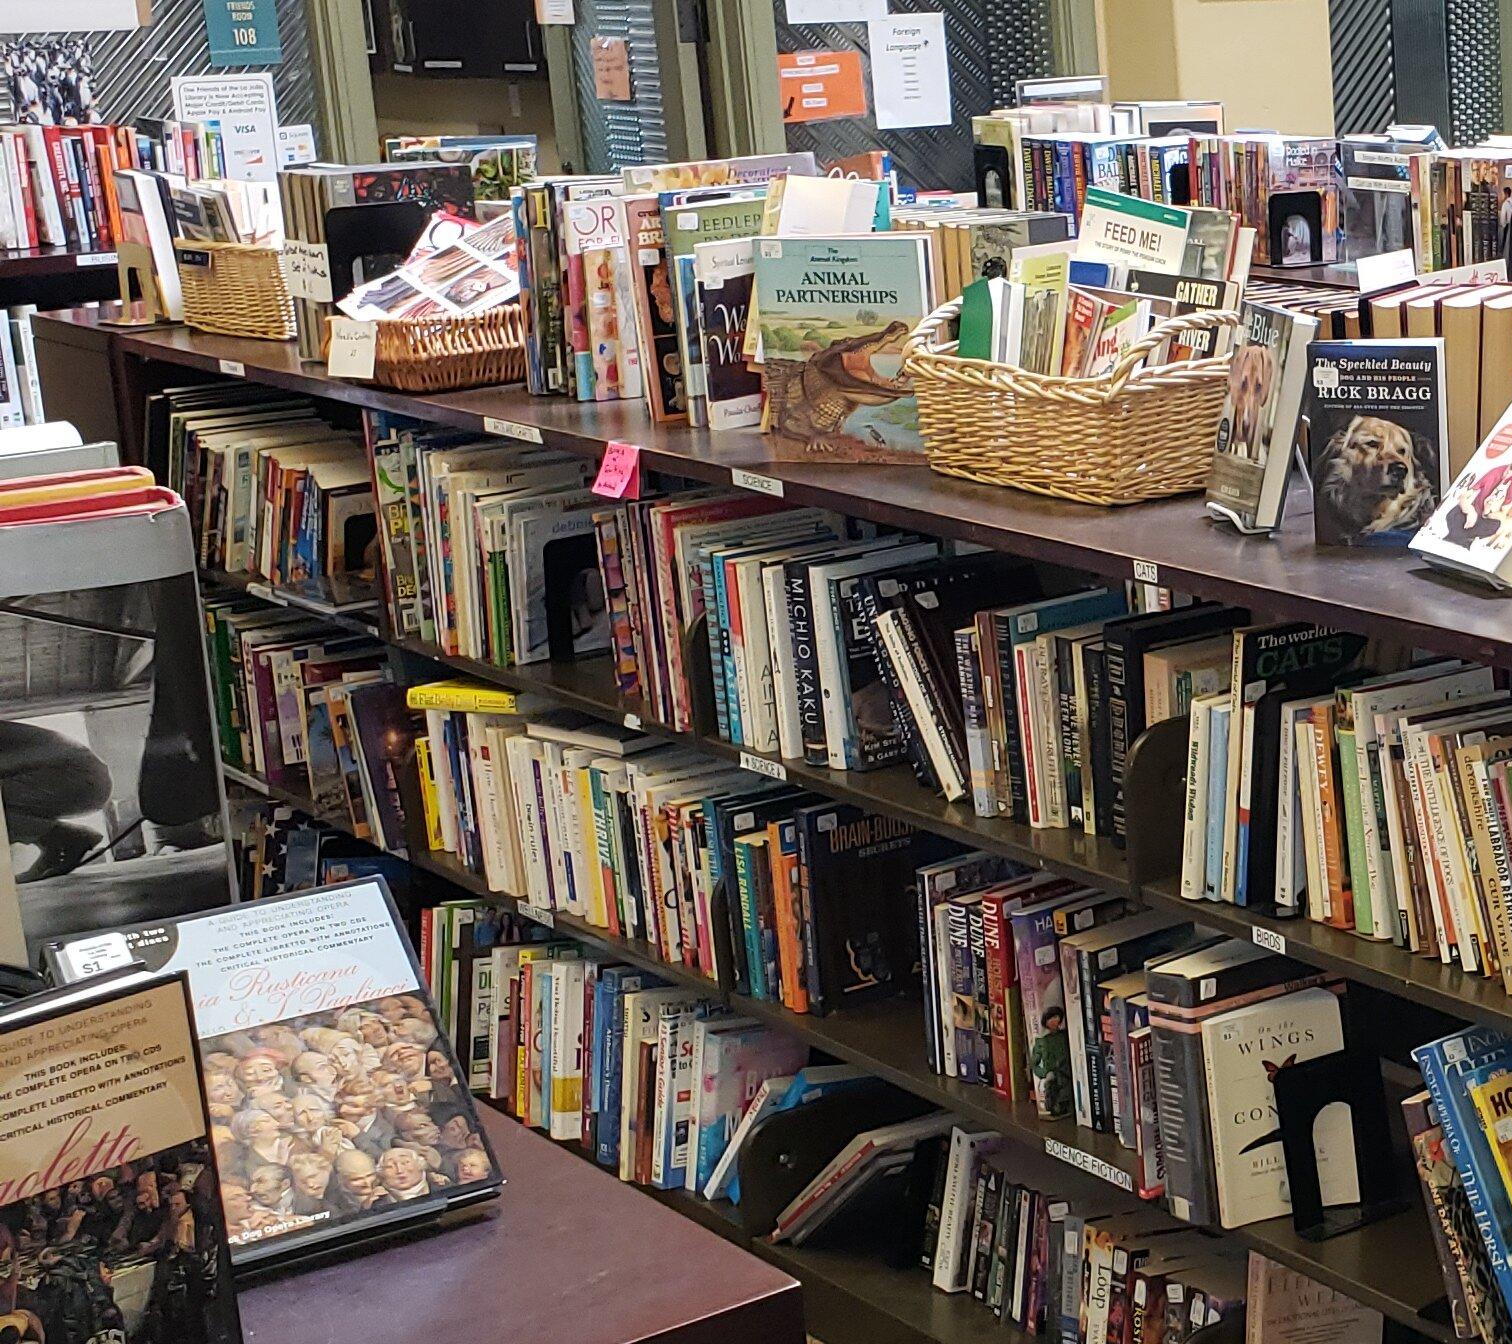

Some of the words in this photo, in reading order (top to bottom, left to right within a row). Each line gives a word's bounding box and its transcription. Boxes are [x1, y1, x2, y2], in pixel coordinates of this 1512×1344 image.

[232, 27, 257, 45] 108
[893, 27, 921, 36] Foreign
[886, 42, 921, 52] Language
[234, 125, 256, 133] VISA
[1105, 221, 1136, 244] FEED
[1139, 231, 1162, 251] ME!
[828, 247, 838, 255] The
[801, 271, 869, 286] ANIMAL
[776, 289, 898, 304] PARTNERSHIPS
[1175, 281, 1218, 306] GATHER
[1179, 328, 1211, 352] RIVER
[1315, 357, 1337, 369] The
[1339, 357, 1388, 372] Speckled
[1391, 358, 1431, 372] Beauty
[1317, 385, 1361, 399] RICK
[1367, 386, 1432, 400] BRAGG
[1136, 562, 1157, 580] CATS
[1258, 634, 1286, 650] The
[1288, 624, 1325, 646] world
[790, 578, 810, 659] MICHIO
[800, 666, 819, 725] KAKU
[1256, 637, 1343, 678] CATS
[751, 757, 776, 778] SCIENCE
[595, 808, 606, 866] THRIVE
[734, 847, 744, 875] LISA
[1489, 820, 1506, 881] LABRADOR
[738, 877, 751, 931] RANDALL
[949, 903, 968, 948] DUNE
[969, 913, 985, 958] DUNE
[981, 899, 1000, 949] DUNE
[1256, 928, 1282, 952] BIRDS
[1238, 1028, 1315, 1056] WINGS
[24, 1067, 47, 1080] THIS
[49, 1059, 75, 1074] BOOK
[47, 1104, 103, 1127] HISTORICAL
[105, 1081, 168, 1110] COMMENTARY
[1046, 1140, 1091, 1171] SCIENCE
[1092, 1161, 1133, 1191] FICTION
